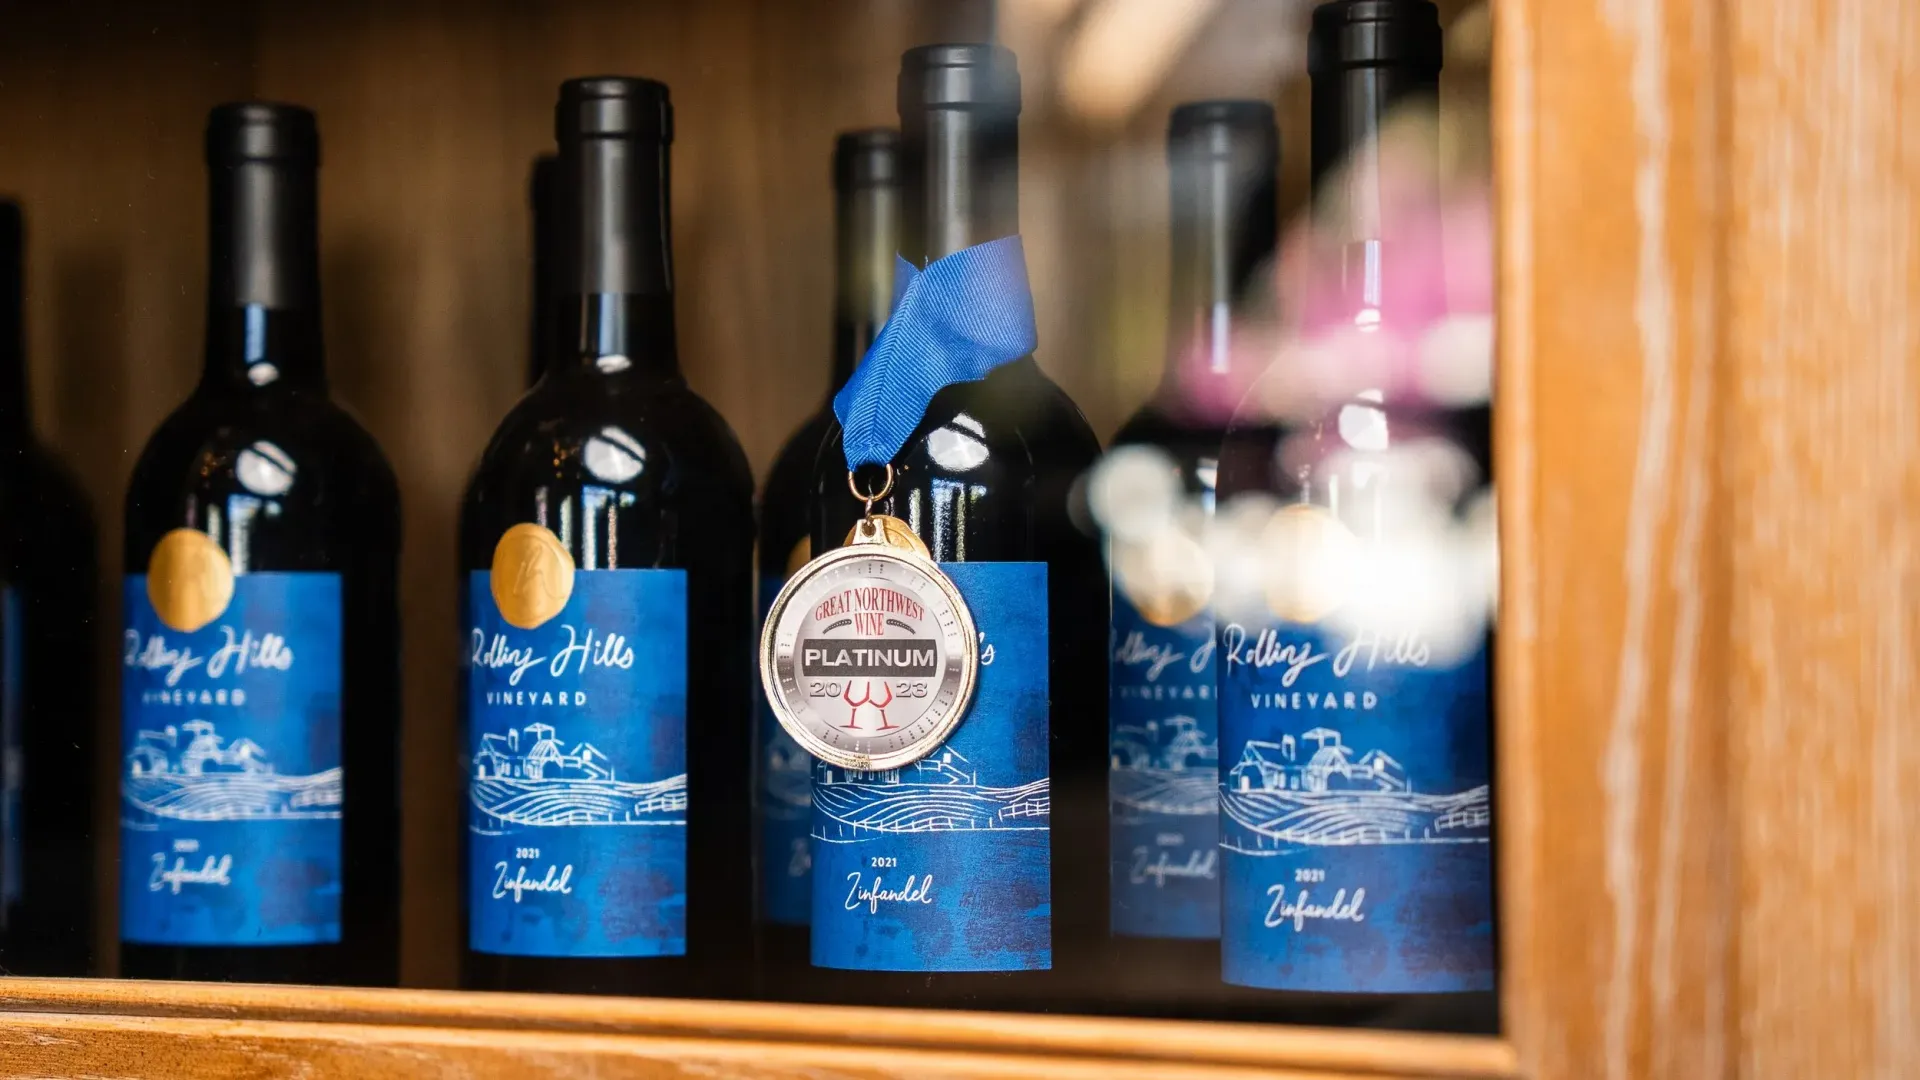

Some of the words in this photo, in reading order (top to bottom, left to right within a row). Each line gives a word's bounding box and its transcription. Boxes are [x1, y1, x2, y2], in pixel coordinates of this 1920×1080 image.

[814, 591, 852, 621] GREAT
[854, 587, 925, 621] NORTHWEST
[854, 612, 885, 636] WINE
[206, 624, 293, 679] Hills
[471, 627, 547, 686] Rolling
[550, 624, 634, 677] Hills
[804, 648, 935, 668] PLATINUM
[1223, 622, 1329, 687] Rolling
[486, 691, 587, 706] VINEYARD
[809, 681, 842, 698] 20
[896, 681, 928, 698] 23
[1250, 691, 1378, 709] VINEYARD
[516, 847, 540, 859] 2021
[871, 857, 897, 867] 2021
[492, 861, 573, 902] Zinfandel
[1294, 868, 1326, 882] 2021
[845, 872, 933, 915] Zinfandel
[1264, 884, 1366, 932] Zinfandel
